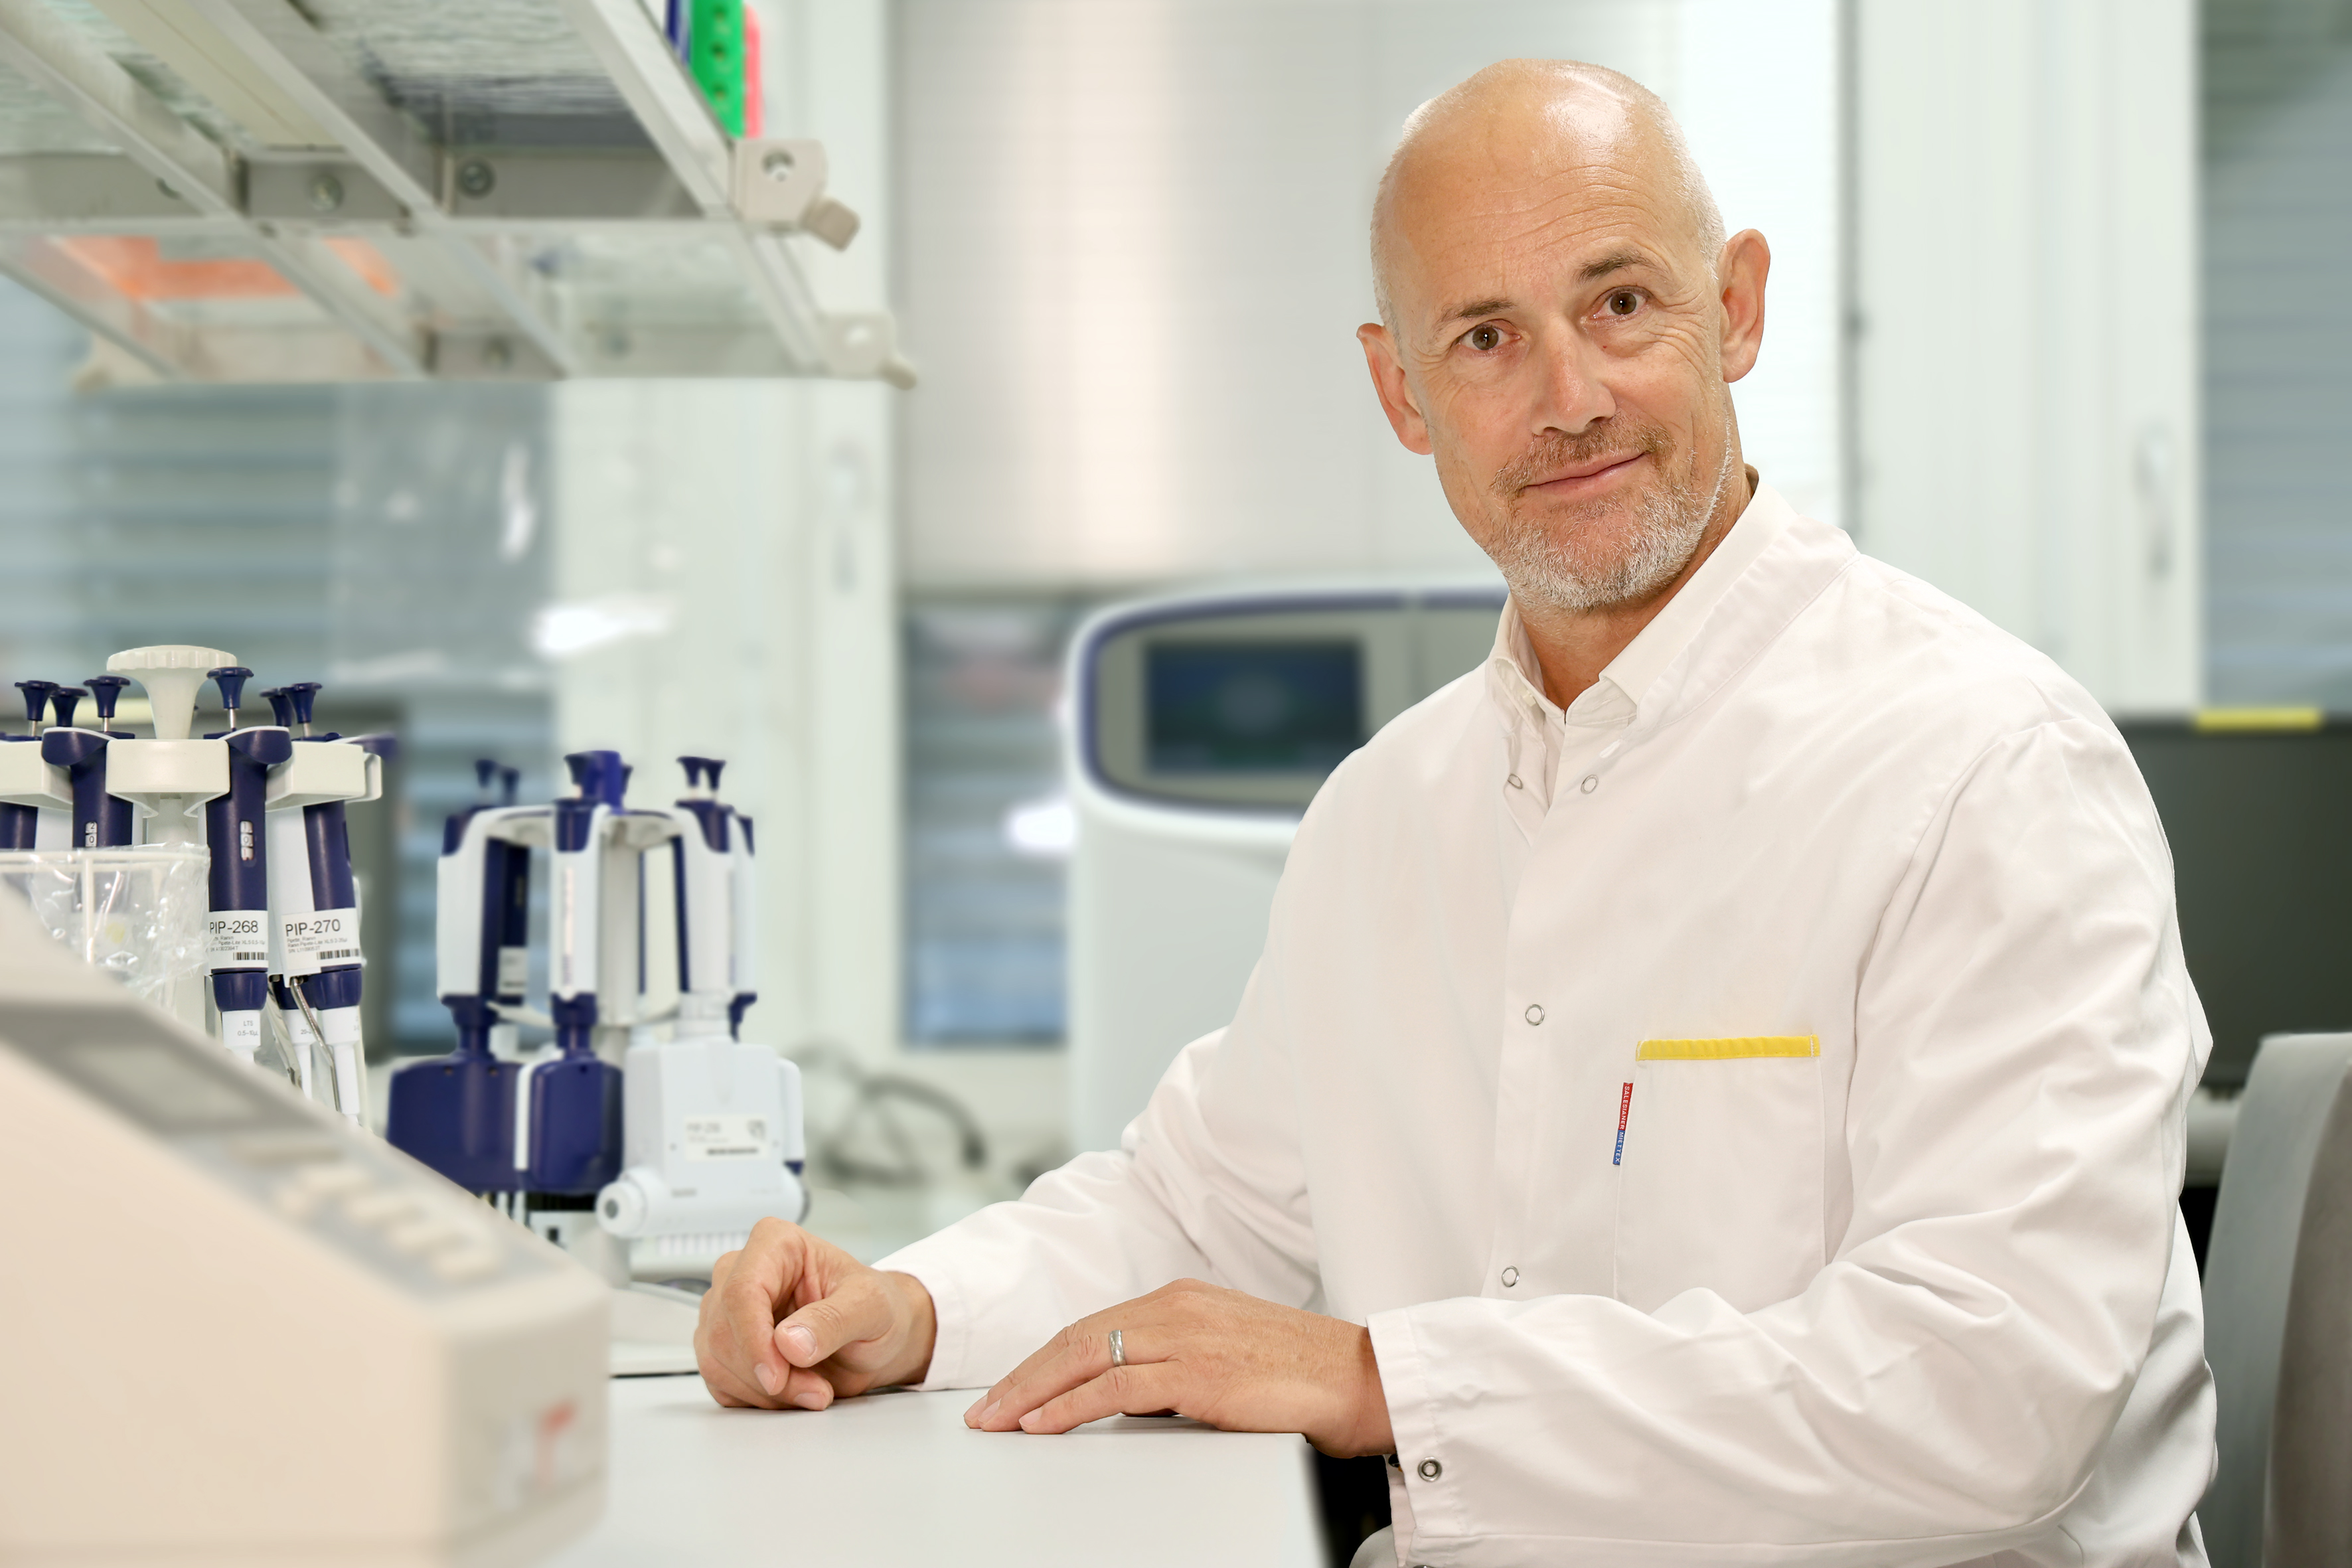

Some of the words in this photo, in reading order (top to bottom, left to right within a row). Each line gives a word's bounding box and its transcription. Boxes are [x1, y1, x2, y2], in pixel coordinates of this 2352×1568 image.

[210, 920, 258, 934] PIP-268
[285, 919, 341, 937] PIP-270
[1620, 1085, 1630, 1129] SALESIANER
[1615, 1131, 1624, 1162] MIETTEX
